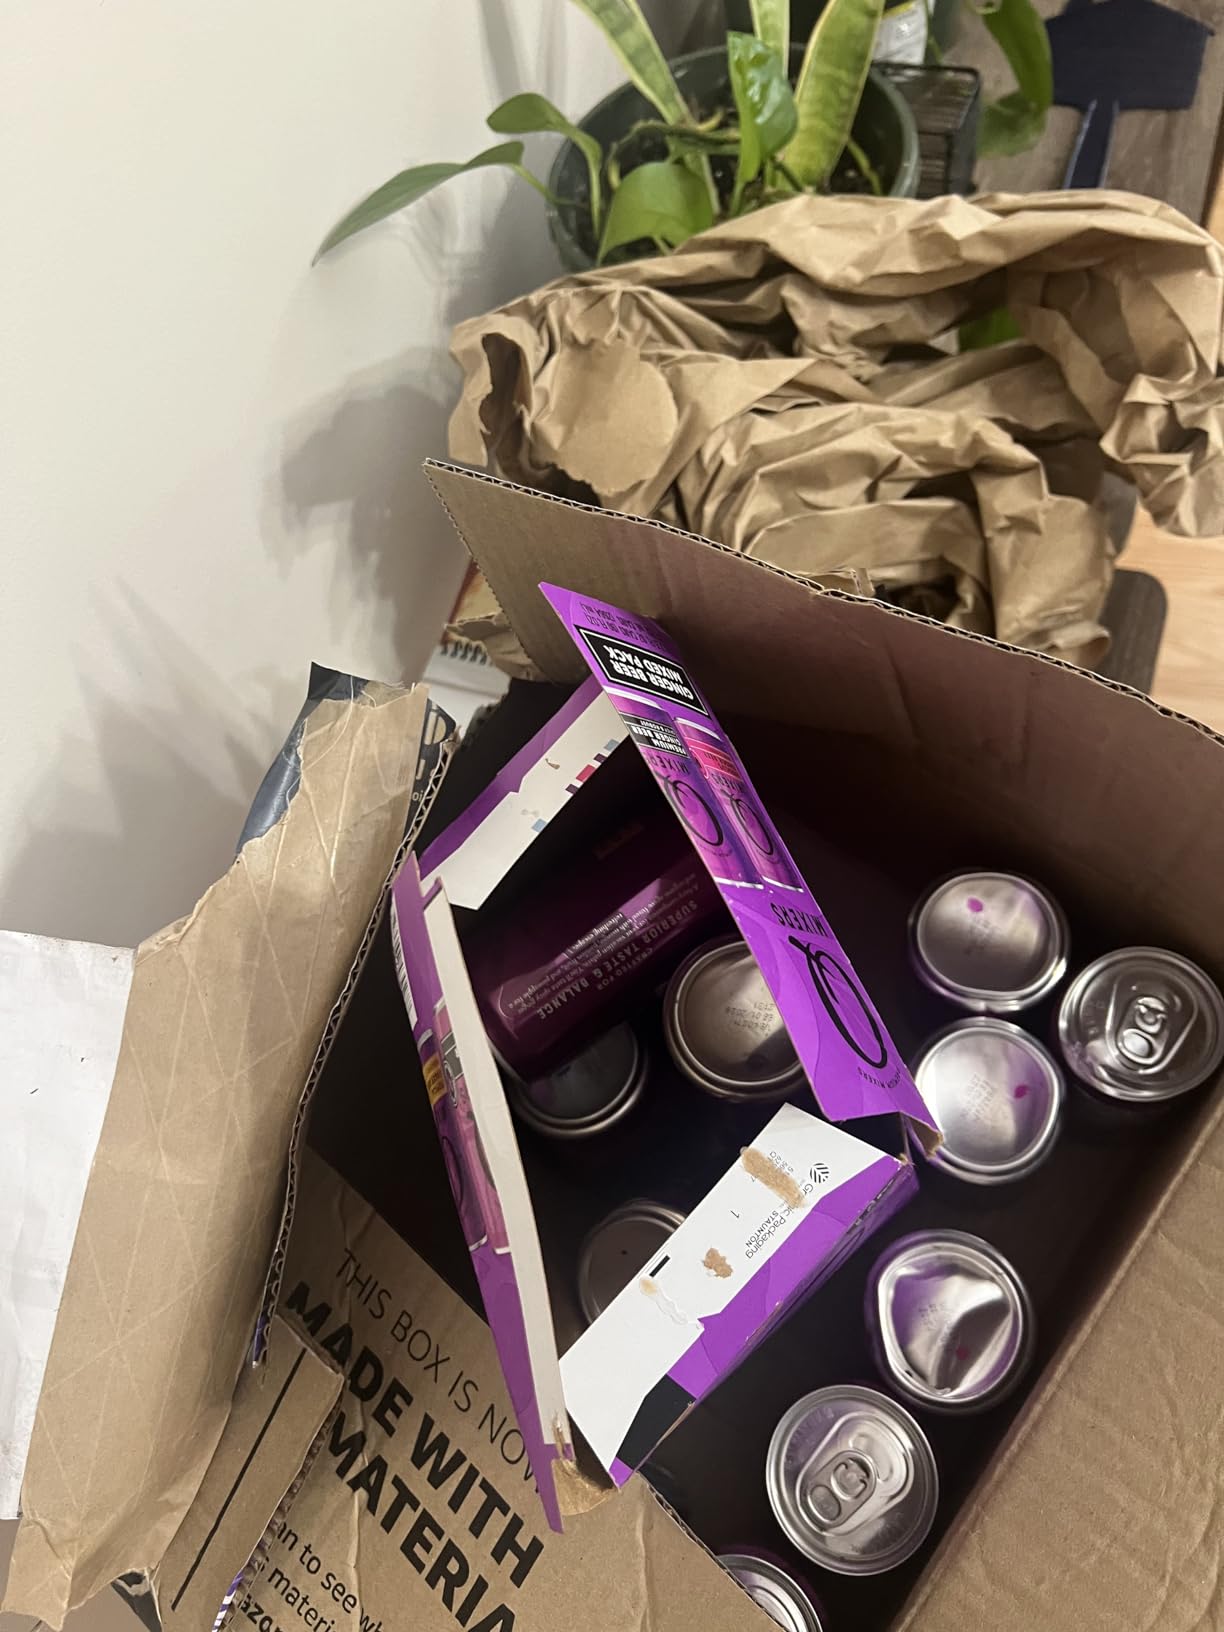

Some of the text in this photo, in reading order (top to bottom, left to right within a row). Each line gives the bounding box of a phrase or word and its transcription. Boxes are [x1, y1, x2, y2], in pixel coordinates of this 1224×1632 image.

[603, 644, 684, 684] MIXED PACK
[610, 659, 694, 700] GINGER BEER
[630, 725, 681, 746] GINGER BEER
[651, 738, 686, 755] PREMIUM
[645, 751, 689, 775] MIXER
[638, 898, 700, 945] SUPERIOR
[770, 902, 828, 938] MIXERS
[601, 941, 641, 972] TASTE
[534, 976, 591, 1020] BALANCE
[744, 1217, 786, 1260] Packaging
[745, 1210, 779, 1248] STAUNTON
[336, 1247, 393, 1320] THIS
[389, 1309, 451, 1384] BOX
[448, 1371, 479, 1413] IS
[285, 1280, 545, 1588] MADE WITH
[299, 1543, 321, 1575] to
[320, 1572, 358, 1614] see
